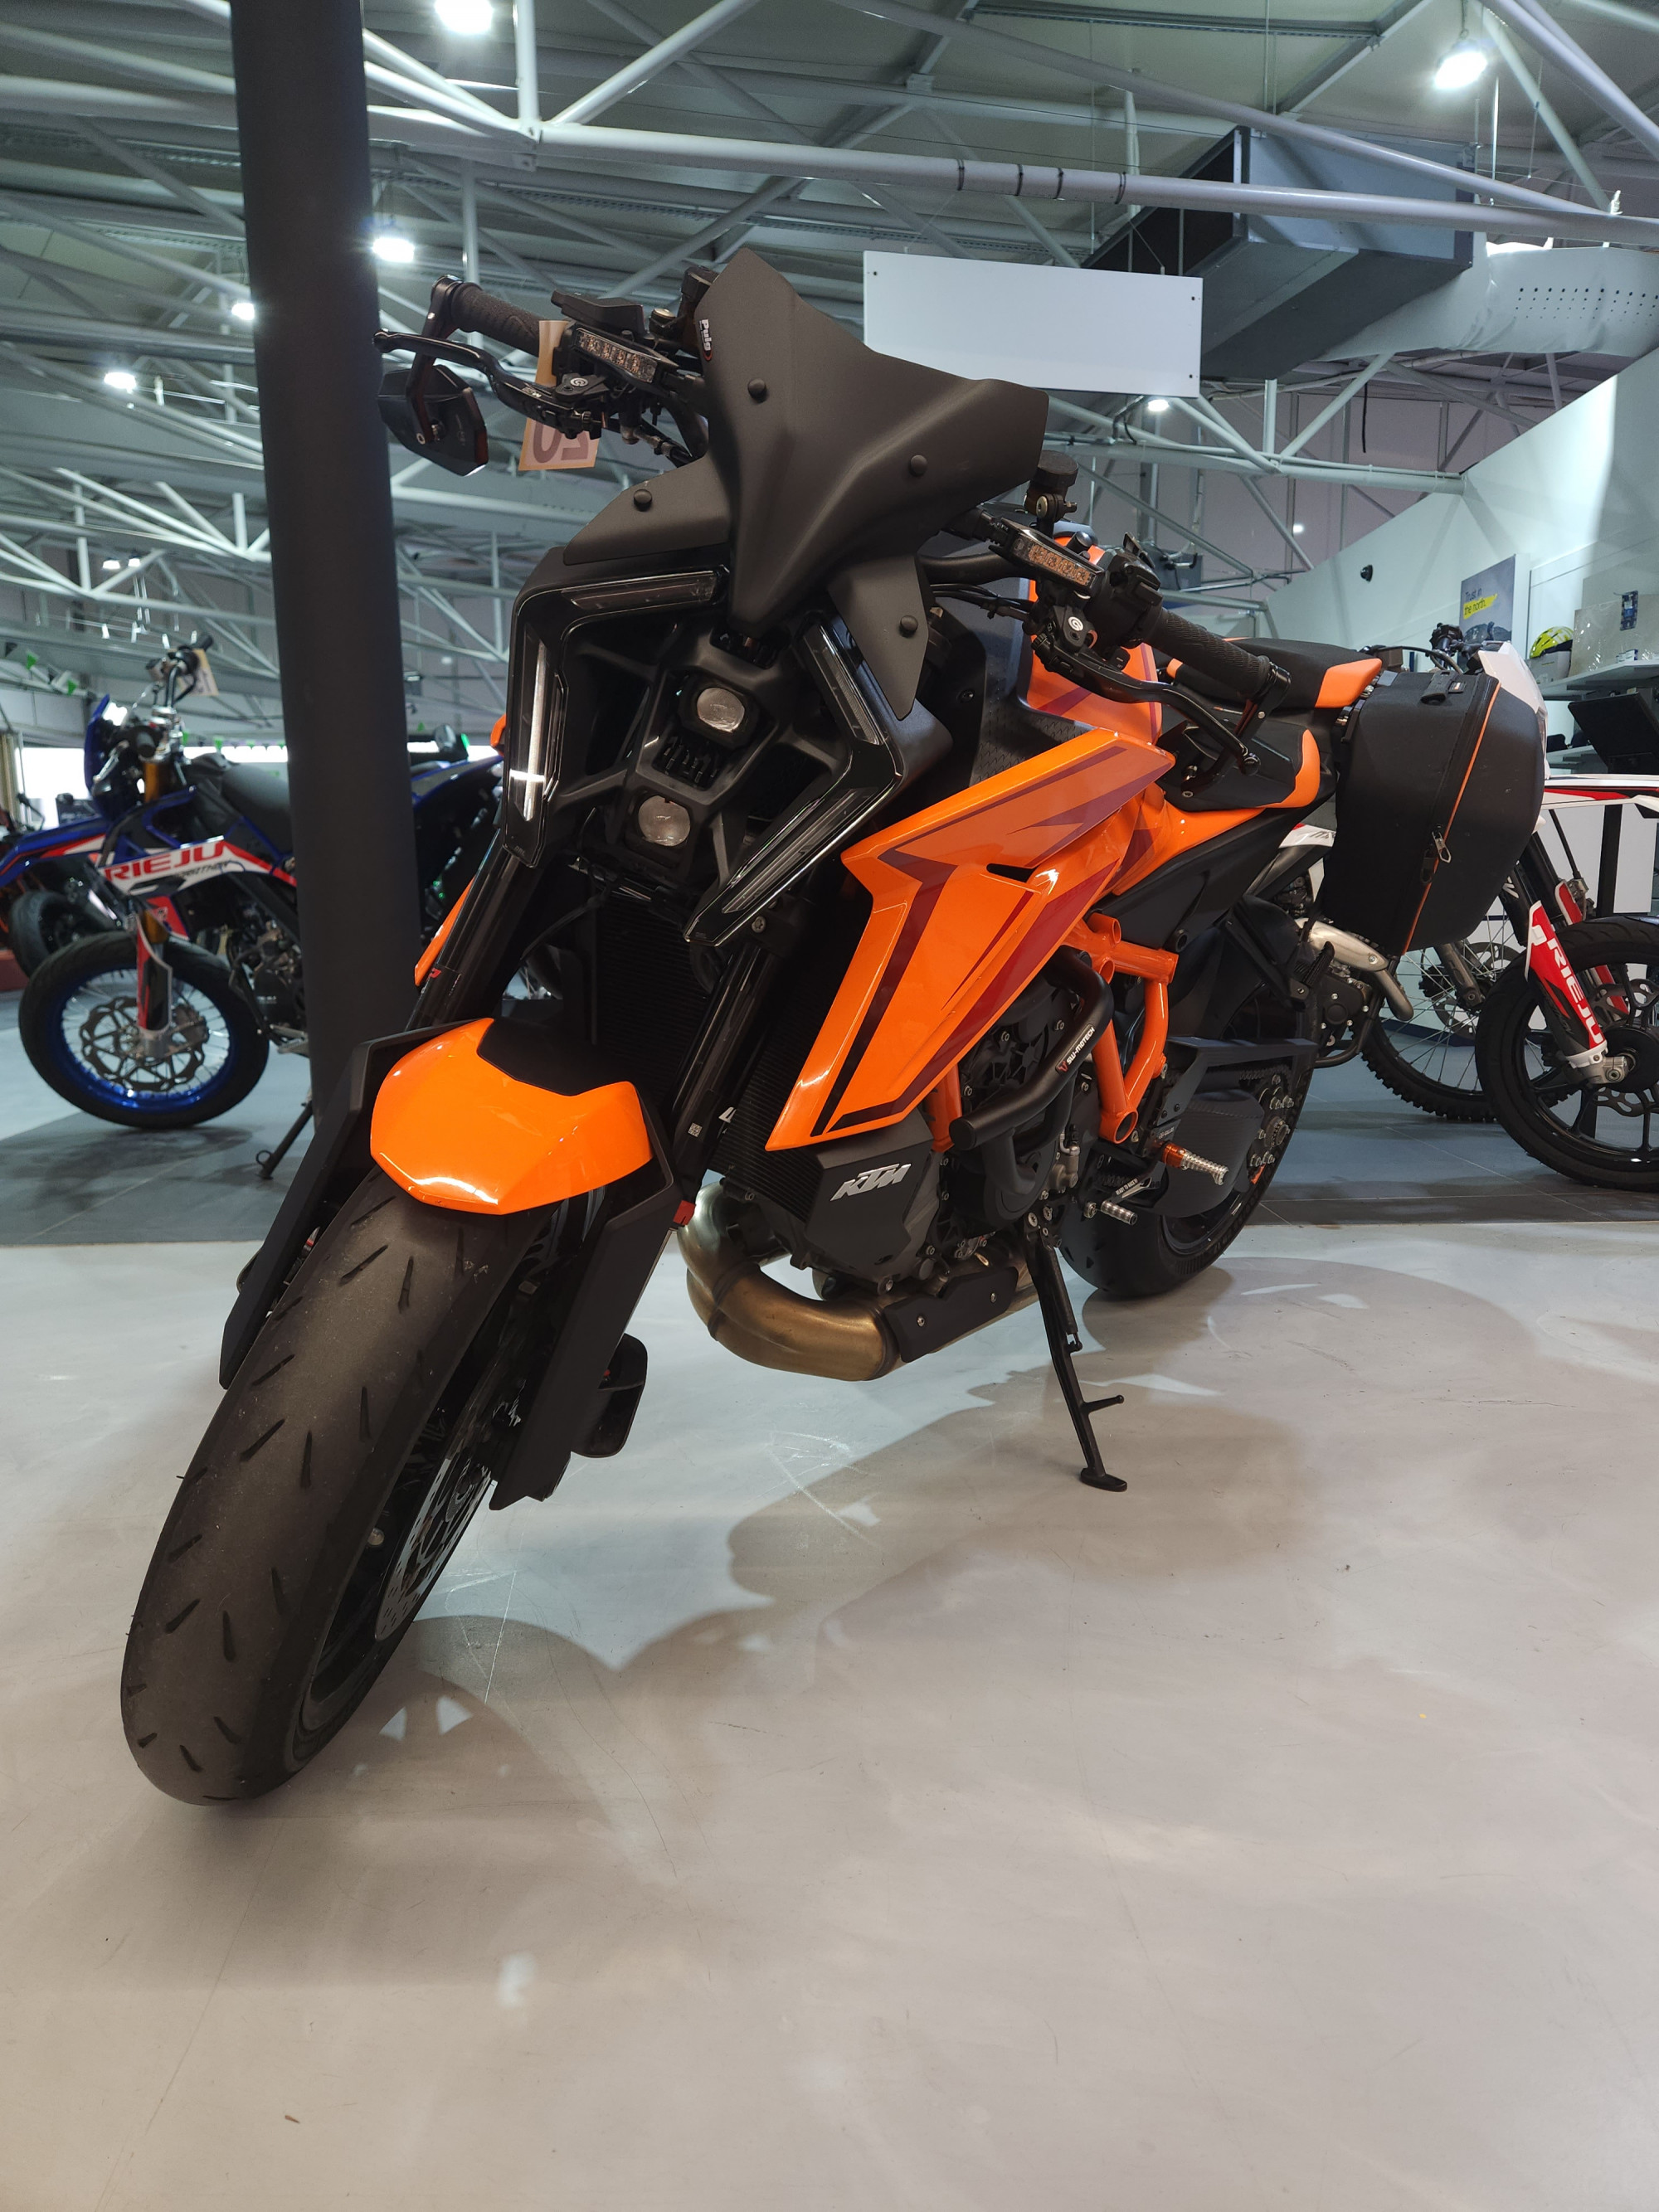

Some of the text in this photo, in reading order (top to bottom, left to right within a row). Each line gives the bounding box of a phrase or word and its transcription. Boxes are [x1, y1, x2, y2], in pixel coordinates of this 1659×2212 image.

[702, 318, 712, 351] Puig
[104, 840, 224, 882] RIEJU
[1546, 937, 1604, 1044] RIEJU
[1067, 1026, 1095, 1065] SW-MOTECH
[830, 1163, 912, 1202] KTM
